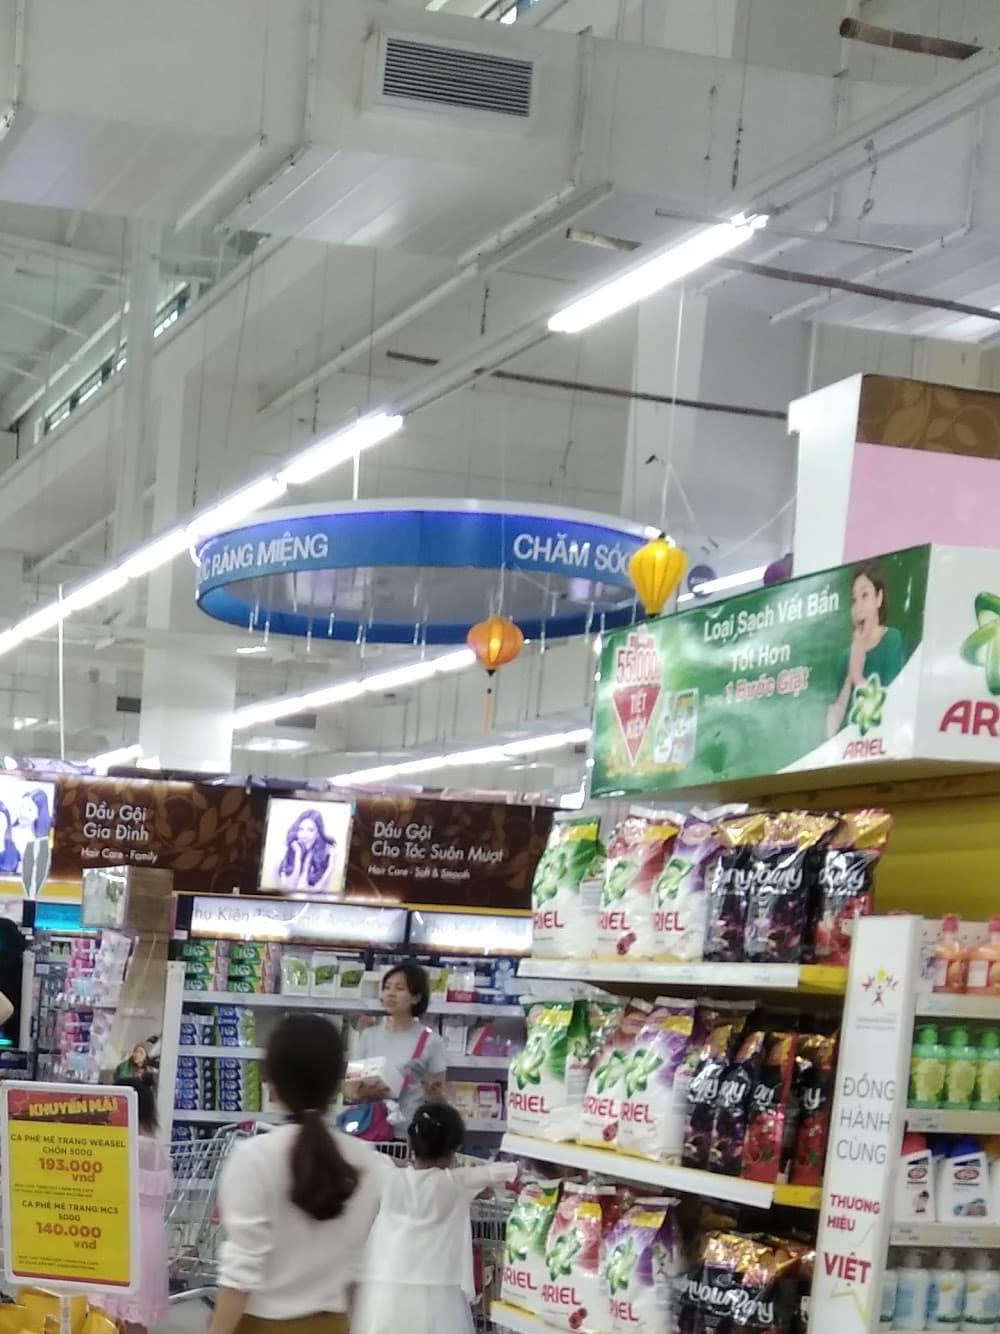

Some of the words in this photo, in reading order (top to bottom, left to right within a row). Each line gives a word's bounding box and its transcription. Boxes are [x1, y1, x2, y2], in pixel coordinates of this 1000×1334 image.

[212, 543, 253, 576] RĂNG
[257, 531, 328, 566] MIỆNG
[513, 533, 591, 568] CHĂM
[842, 740, 886, 760] ARIEL
[120, 805, 147, 824] Gội
[83, 822, 111, 839] Gia
[115, 824, 149, 840] Đình
[405, 823, 432, 841] Gội
[81, 848, 100, 857] Hair
[101, 848, 123, 858] Care
[130, 849, 158, 864] Family
[371, 840, 400, 858] Cho
[404, 842, 426, 858] Tóc
[430, 844, 464, 860] Suôn
[533, 911, 564, 930] RIEL
[599, 911, 630, 930] RIEL
[654, 912, 685, 931] RIEL
[622, 1102, 655, 1123] RIEL
[840, 1105, 891, 1131] HÀNH
[58, 1136, 87, 1145] TRANG
[90, 1138, 126, 1148] WEASEL
[836, 1136, 887, 1164] CÙNG
[39, 1157, 103, 1174] 193.000
[72, 1172, 96, 1183] vnd
[68, 1203, 98, 1213] TRANG
[36, 1222, 102, 1239] 140.000
[73, 1239, 97, 1250] vnd
[824, 1251, 872, 1287] VIỆT
